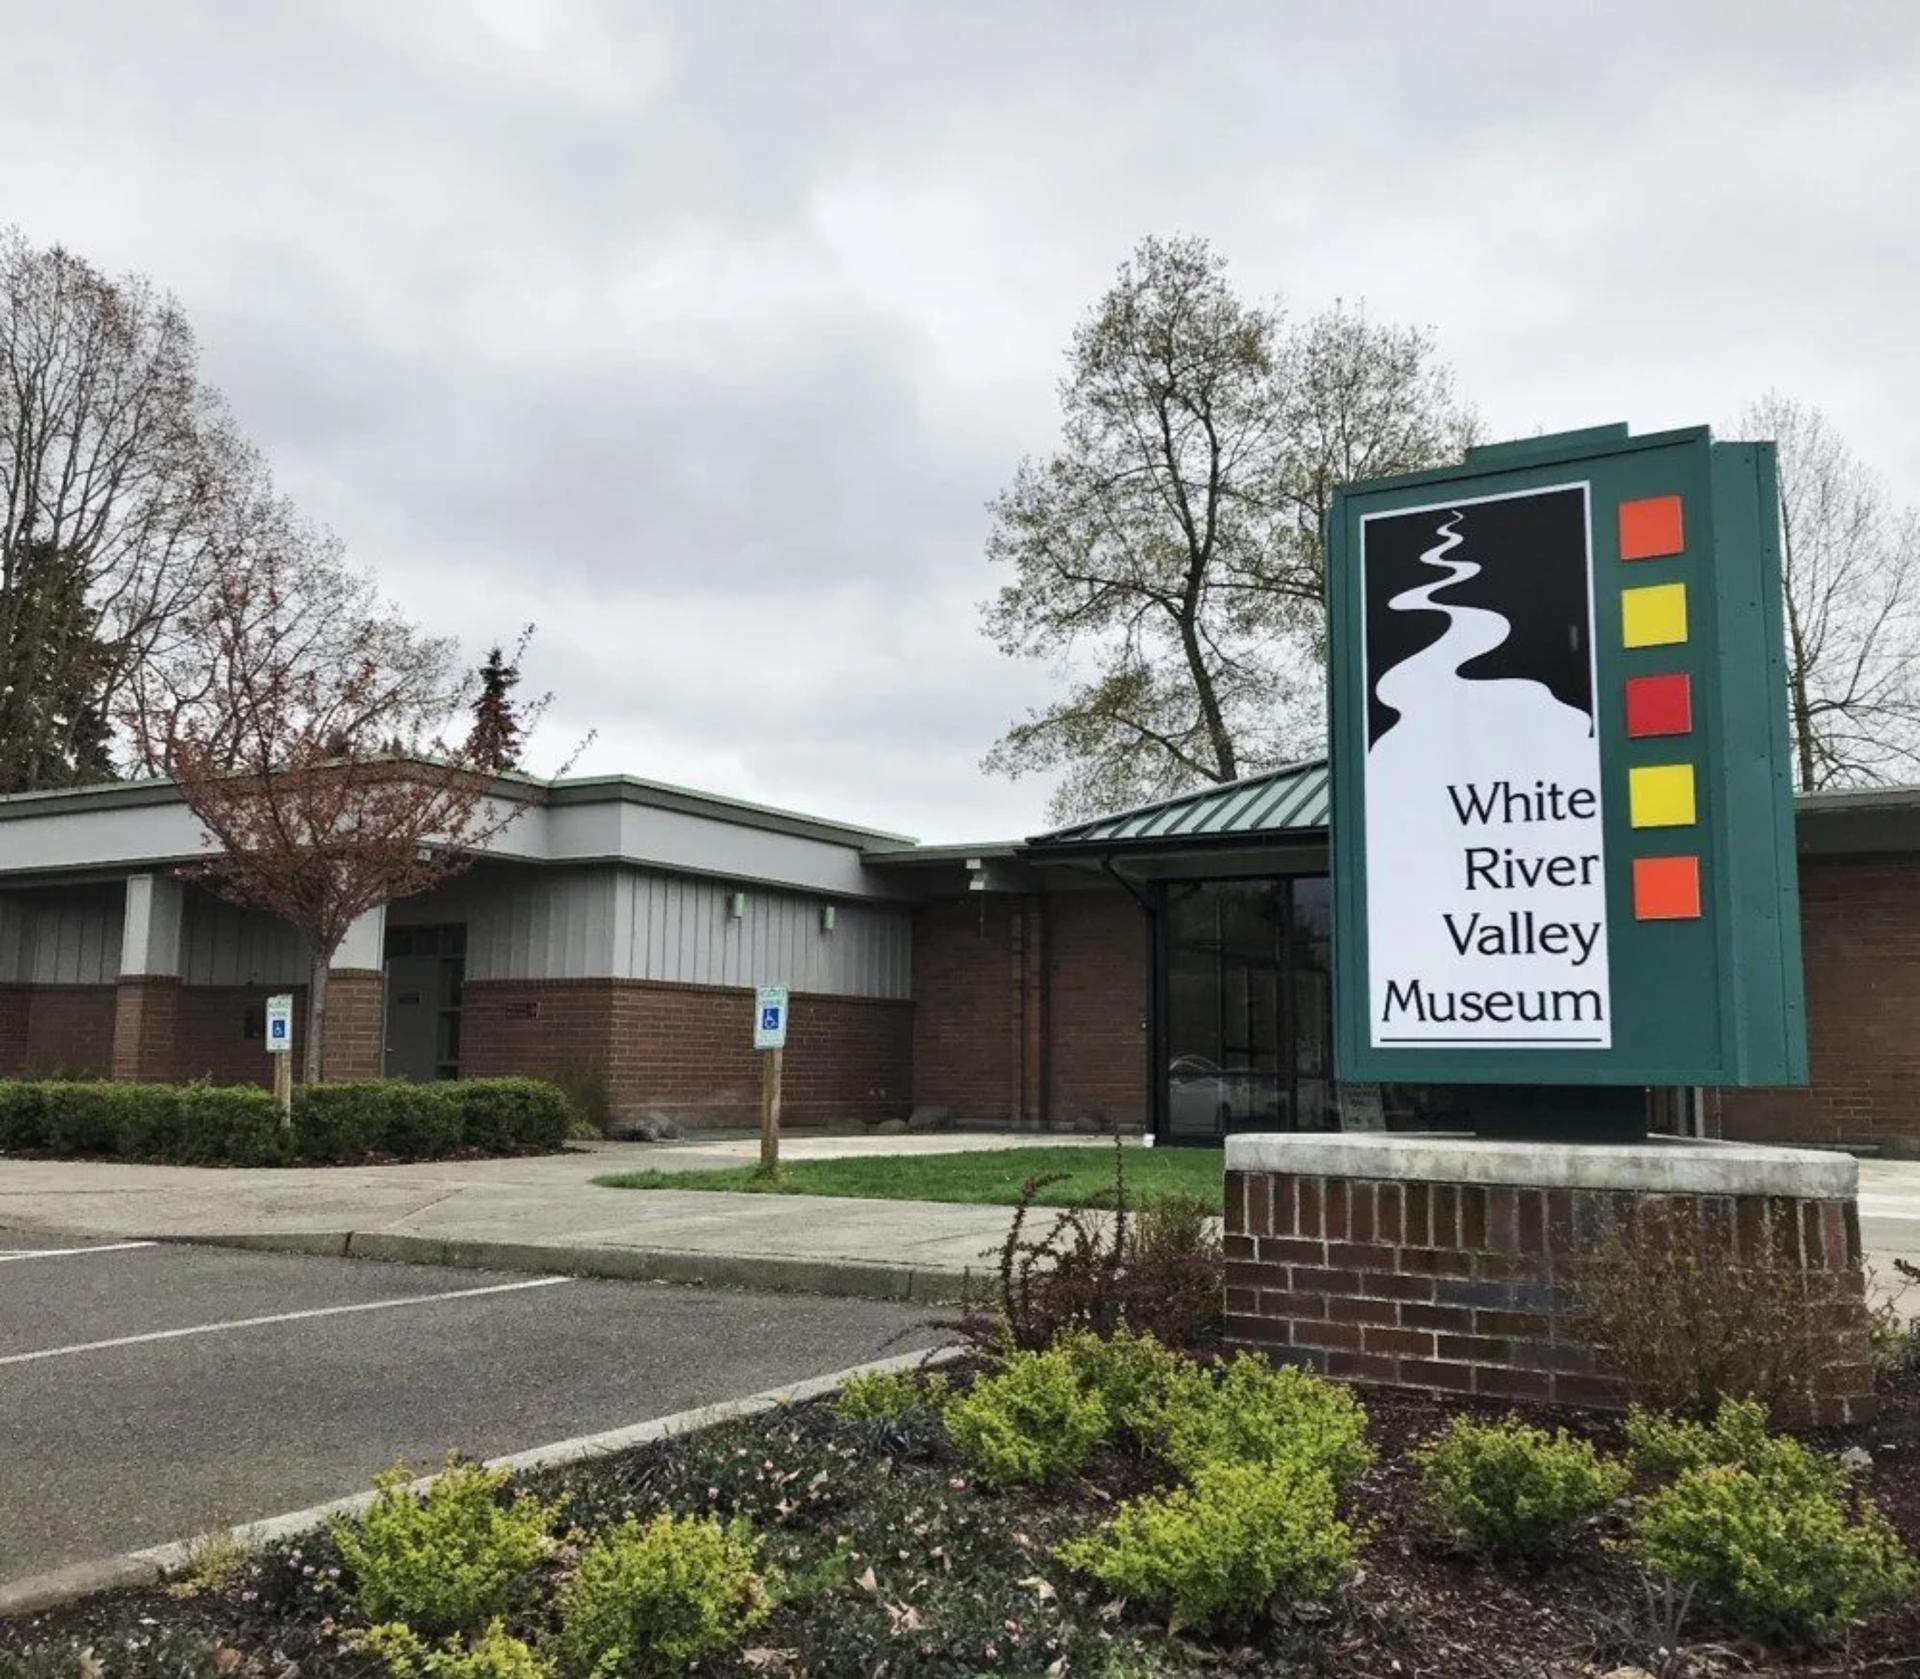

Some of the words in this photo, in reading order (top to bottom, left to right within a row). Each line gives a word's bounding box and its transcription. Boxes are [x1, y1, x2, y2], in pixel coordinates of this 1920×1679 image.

[1446, 781, 1597, 826] White
[1464, 847, 1599, 890] River
[1442, 911, 1602, 966] Valley
[1381, 979, 1604, 1023] Museum
